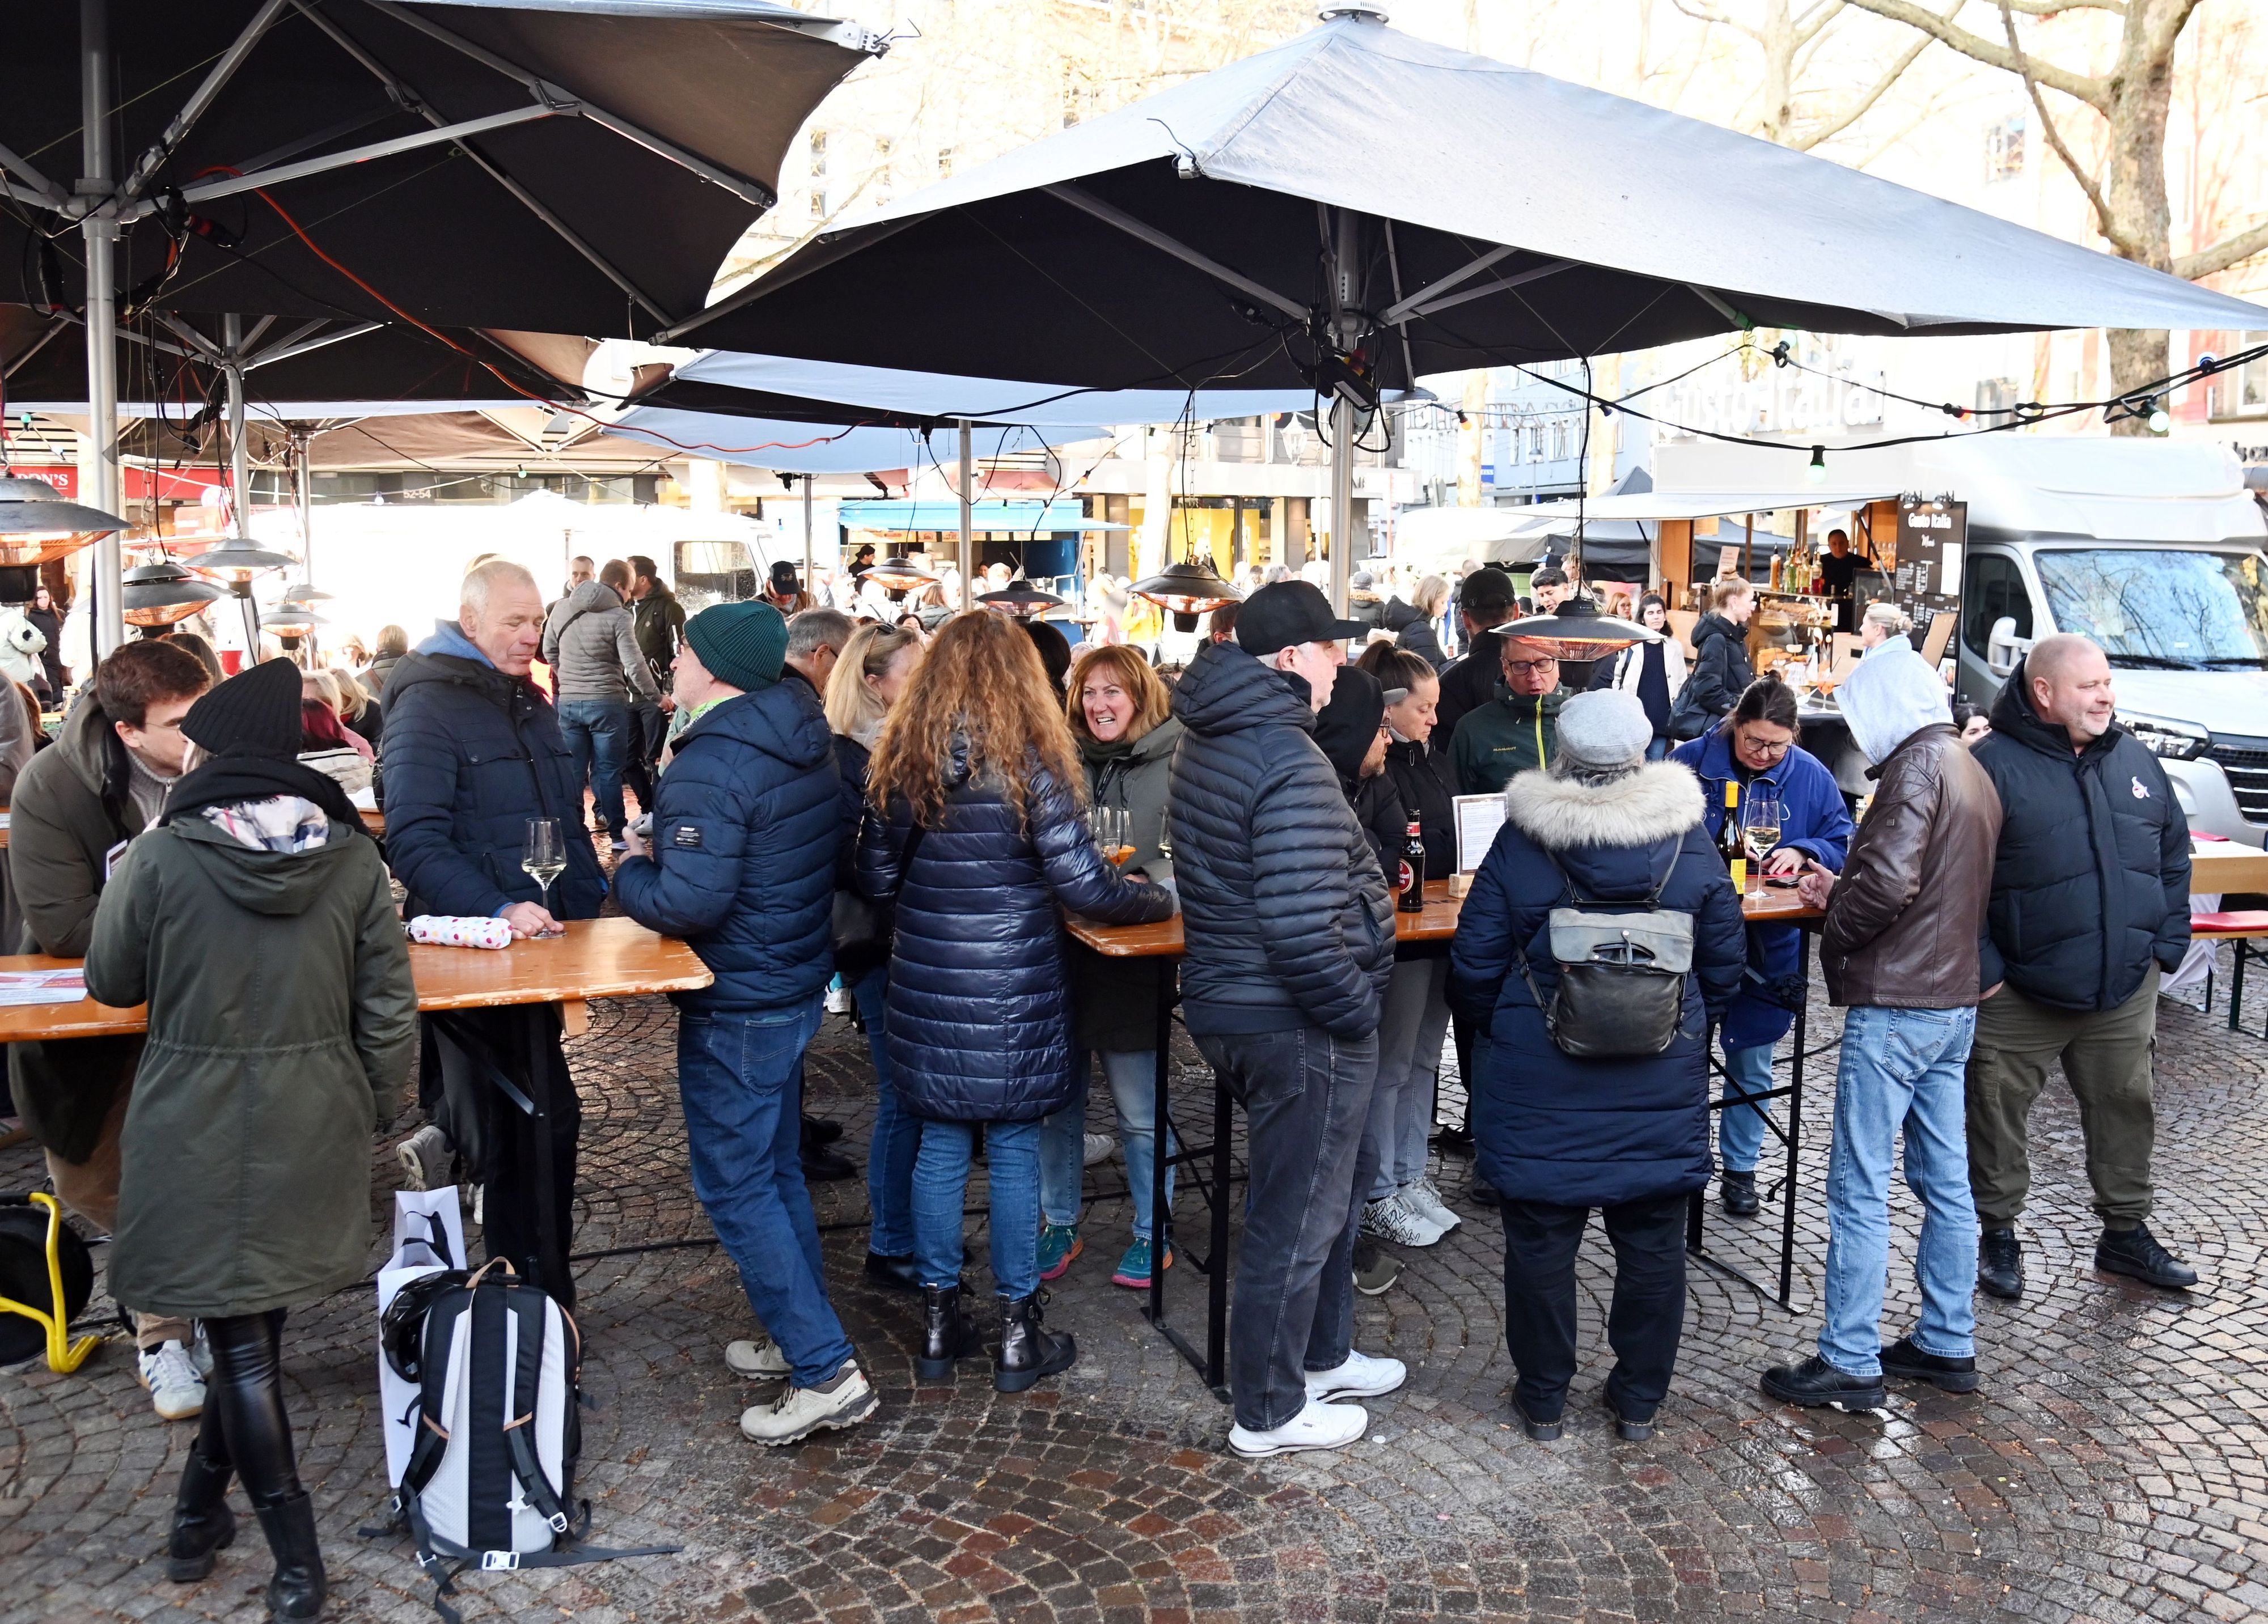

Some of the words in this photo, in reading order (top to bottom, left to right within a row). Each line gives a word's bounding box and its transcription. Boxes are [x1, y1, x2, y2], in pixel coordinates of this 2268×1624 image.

[403, 488, 431, 499] 52-54
[1908, 512, 1931, 528] Gusto
[1931, 513, 1952, 529] Italia
[837, 1386, 857, 1405] MAMMUT
